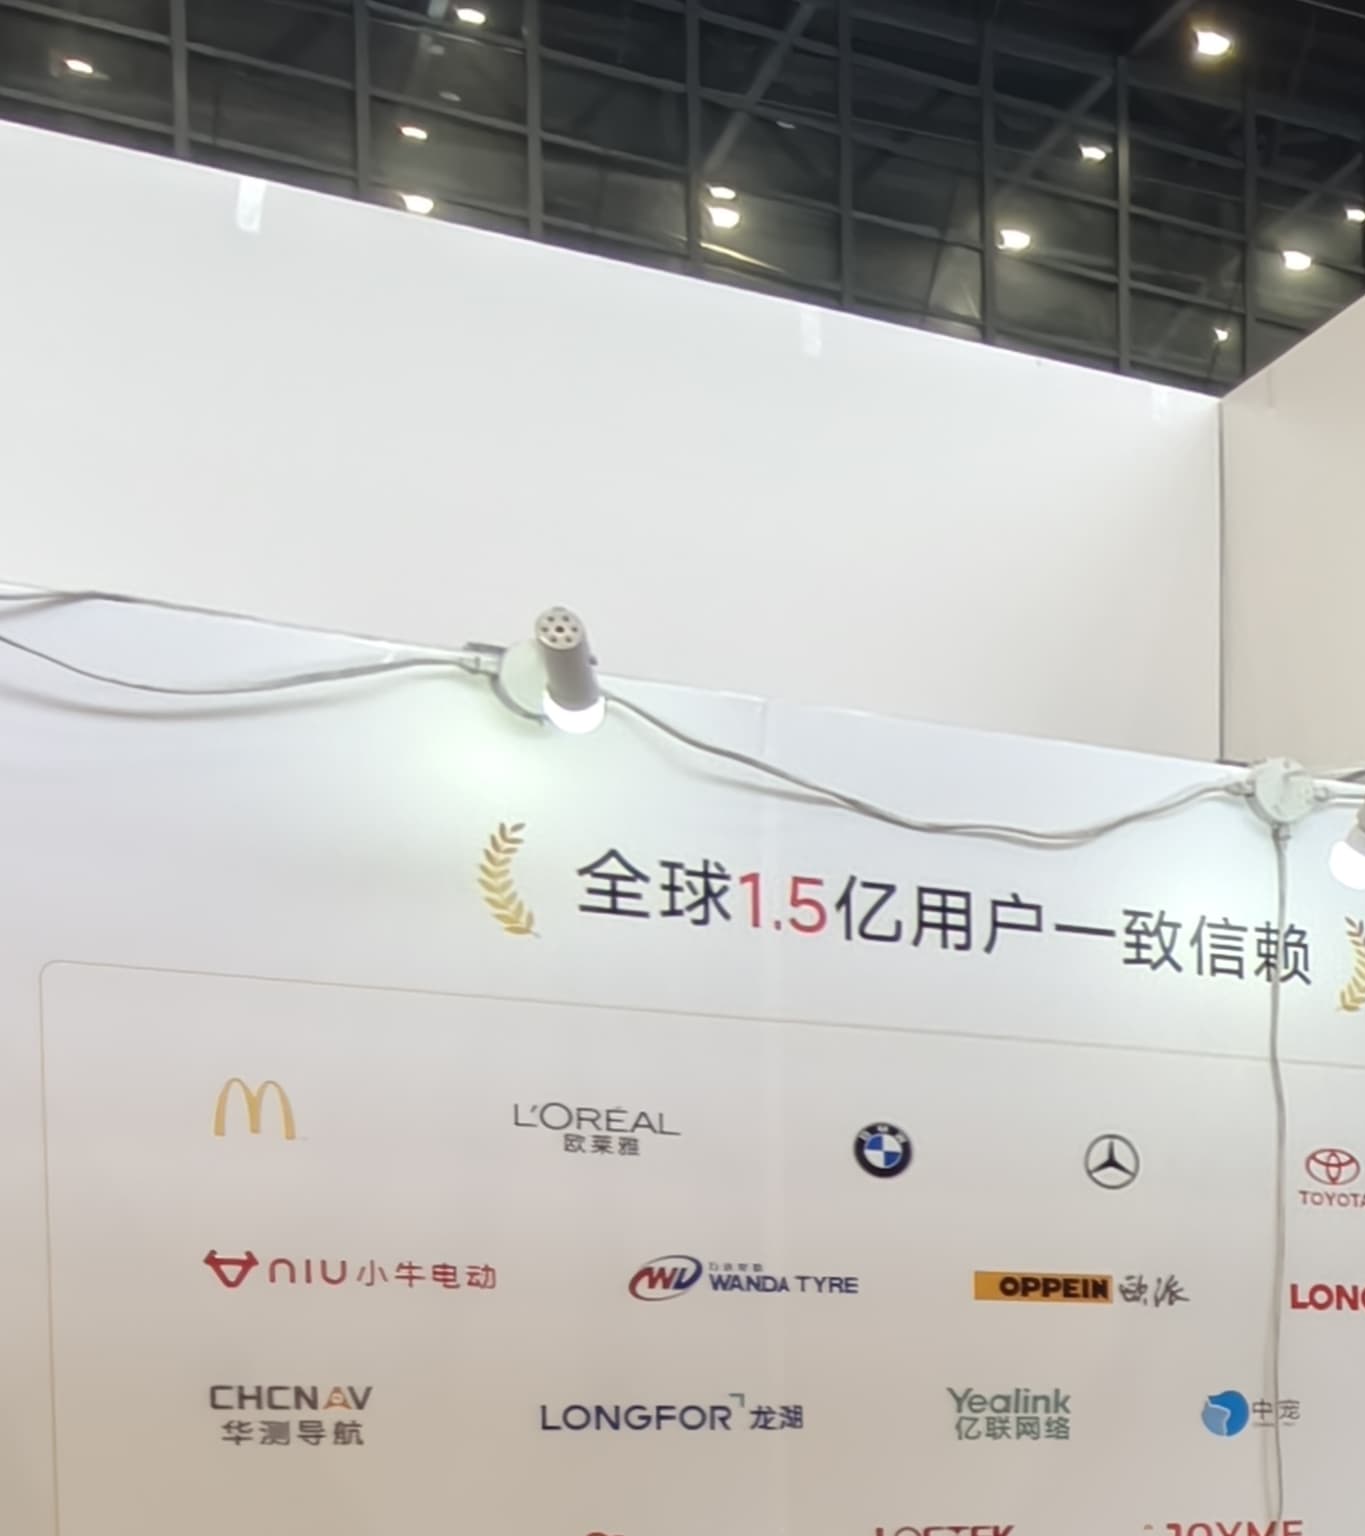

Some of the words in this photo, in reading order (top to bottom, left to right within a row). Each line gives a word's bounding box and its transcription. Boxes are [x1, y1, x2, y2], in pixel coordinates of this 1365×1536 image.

[576, 847, 1313, 986] 全球1.5亿用户一致信赖
[563, 1134, 641, 1157] 欧莱雅
[356, 1260, 497, 1291] 小牛电动
[709, 1274, 790, 1294] WANDA
[794, 1275, 859, 1295] TYRE
[999, 1278, 1110, 1302] OPPEIN
[208, 1385, 373, 1412] CHCNAV
[945, 1386, 1071, 1418] Yealink
[539, 1404, 733, 1432] LONGFOR
[748, 1404, 805, 1431] 龙湖
[954, 1415, 1071, 1442] 亿联网络
[221, 1420, 366, 1446] 华测导航
